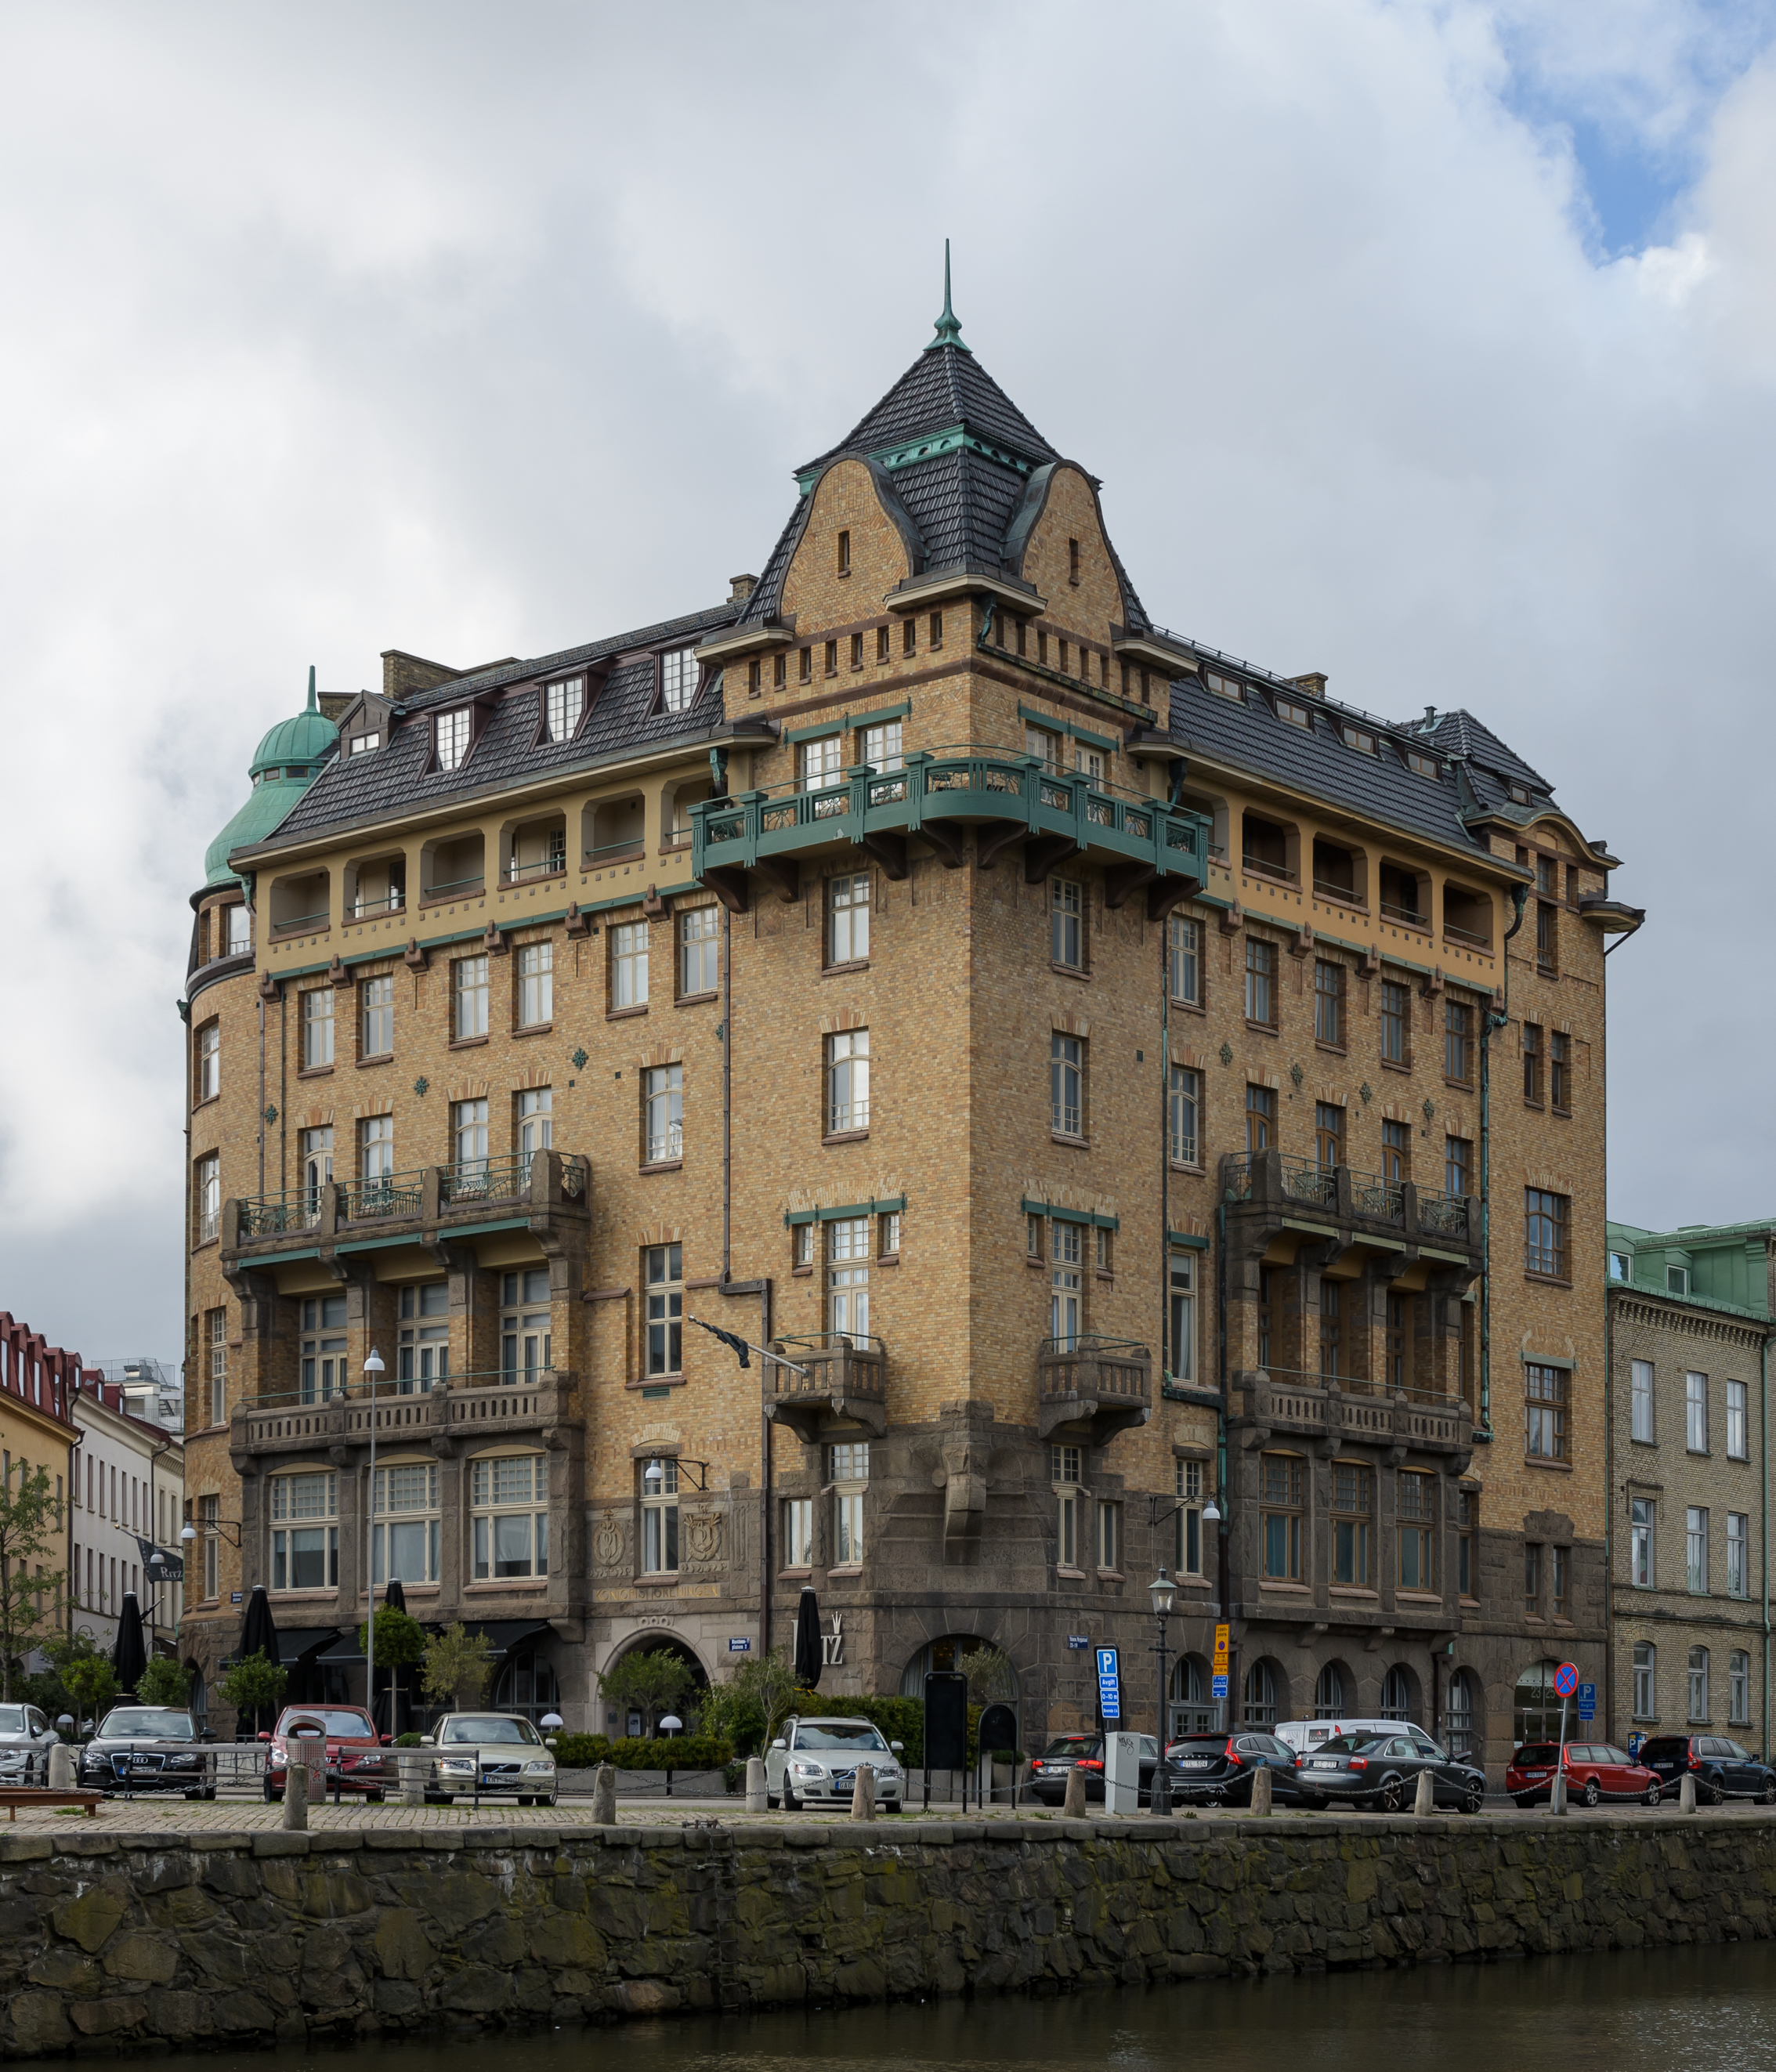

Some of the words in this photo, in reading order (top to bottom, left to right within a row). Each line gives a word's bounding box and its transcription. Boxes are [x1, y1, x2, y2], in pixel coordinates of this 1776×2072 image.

[1103, 1653, 1112, 1672] P
[1531, 1686, 1541, 1698] 23
[1583, 1685, 1592, 1699] P
[1630, 1739, 1637, 1748] P
